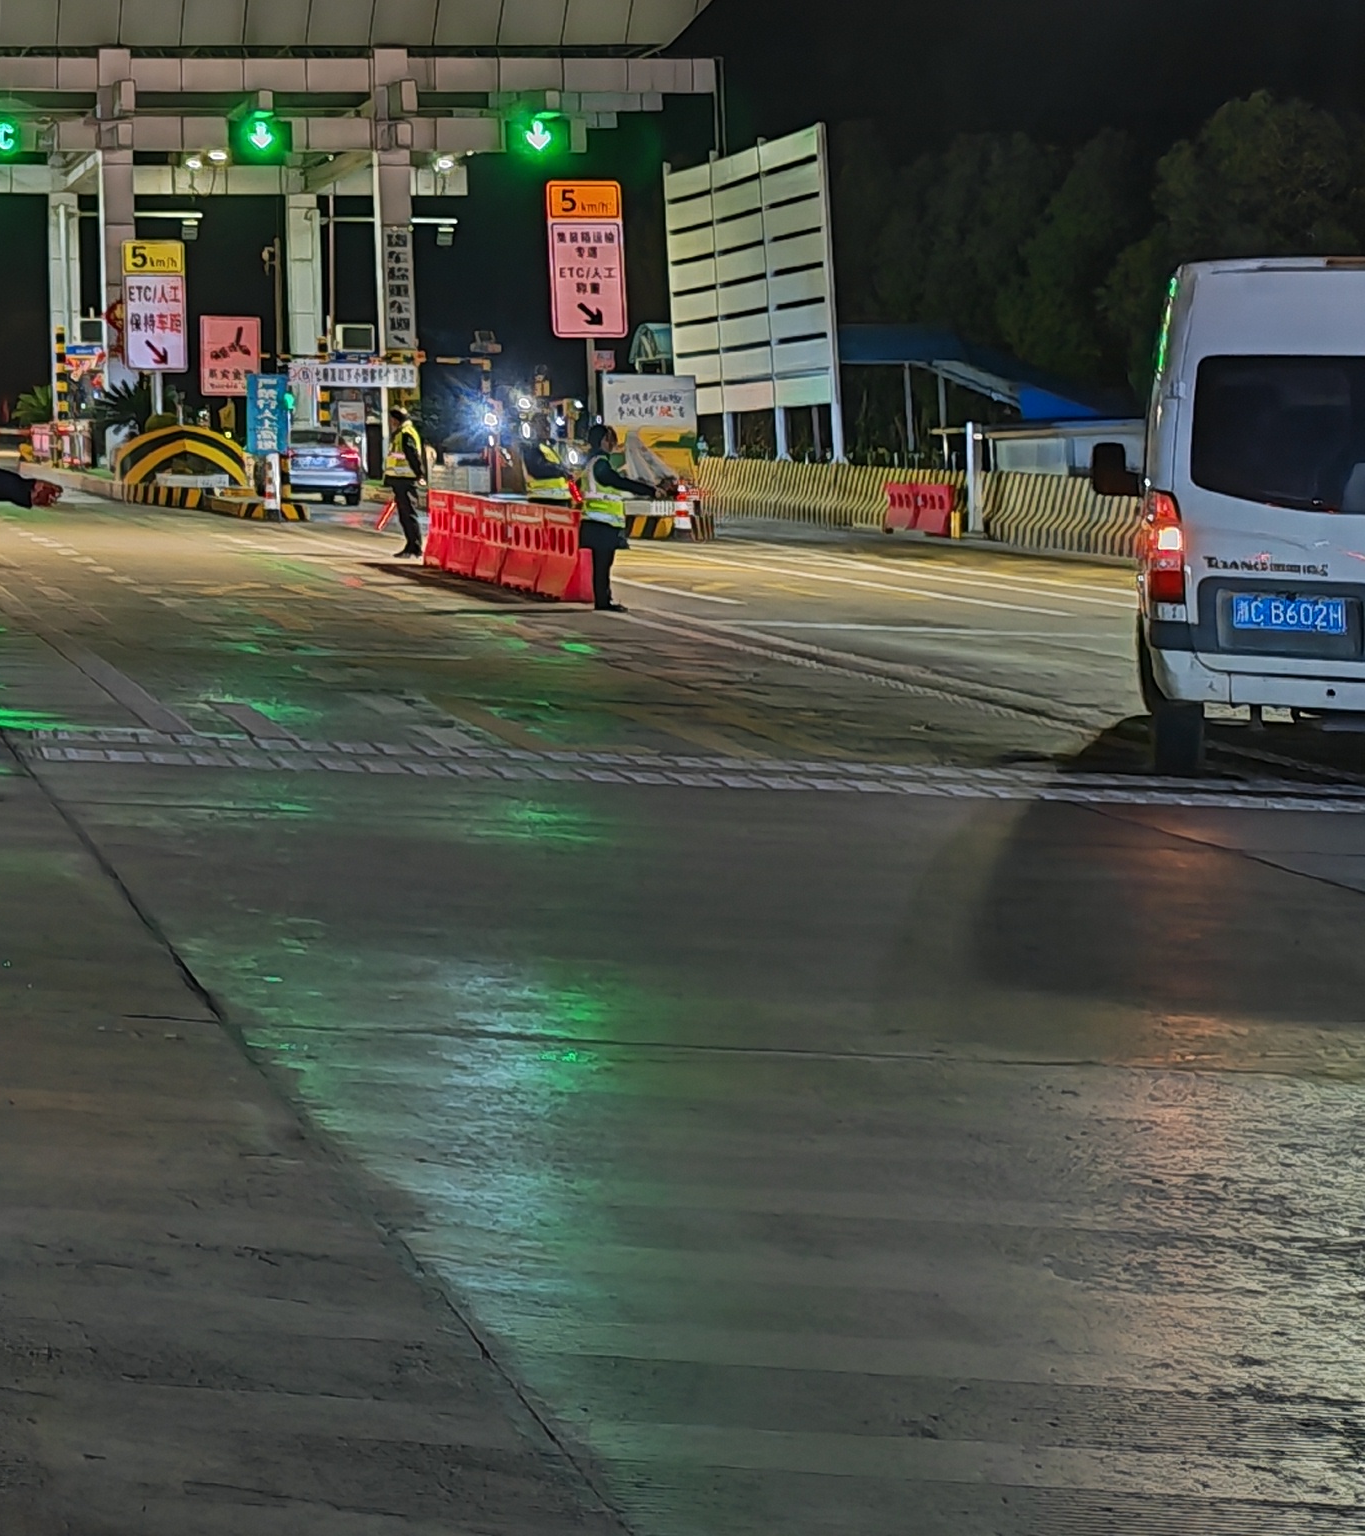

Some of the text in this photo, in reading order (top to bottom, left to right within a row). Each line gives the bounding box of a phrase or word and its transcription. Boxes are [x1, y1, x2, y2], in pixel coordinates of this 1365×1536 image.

[561, 189, 577, 212] 5
[131, 245, 147, 268] 5
[559, 267, 617, 280] ETC/人工
[128, 284, 182, 303] ETC/人工
[130, 312, 182, 334] 保持车距
